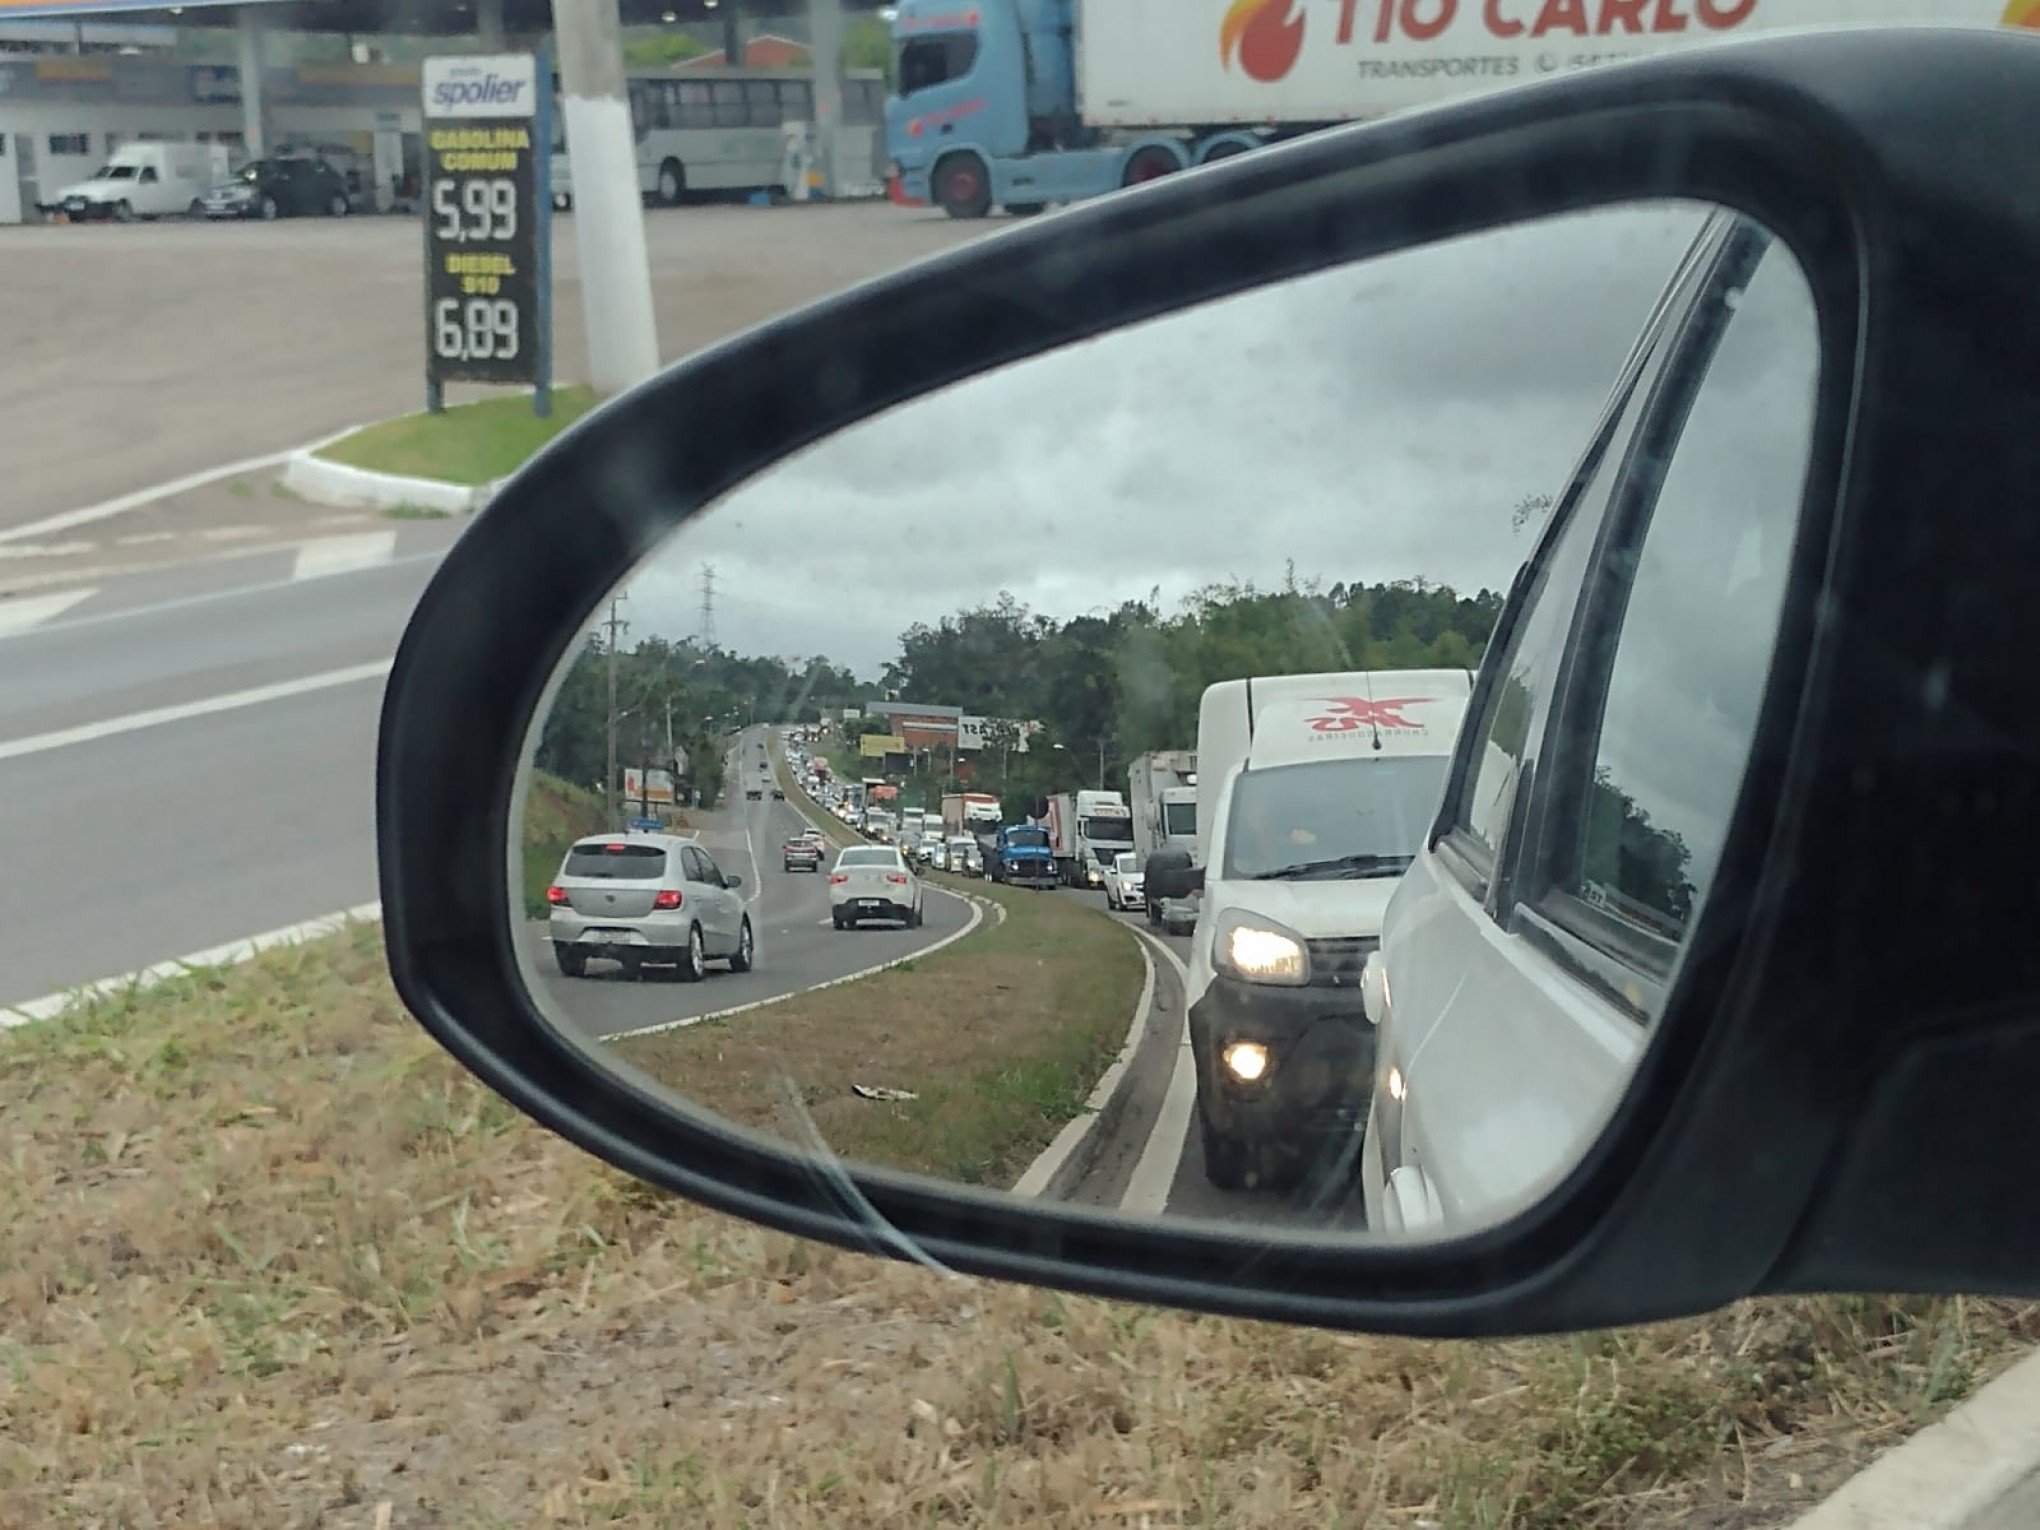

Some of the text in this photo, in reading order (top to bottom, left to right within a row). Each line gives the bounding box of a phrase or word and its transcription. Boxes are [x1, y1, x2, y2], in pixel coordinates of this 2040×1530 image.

[1358, 55, 1520, 79] TRANSPORTES
[433, 179, 517, 242] 5,99
[435, 299, 519, 361] 6,89
